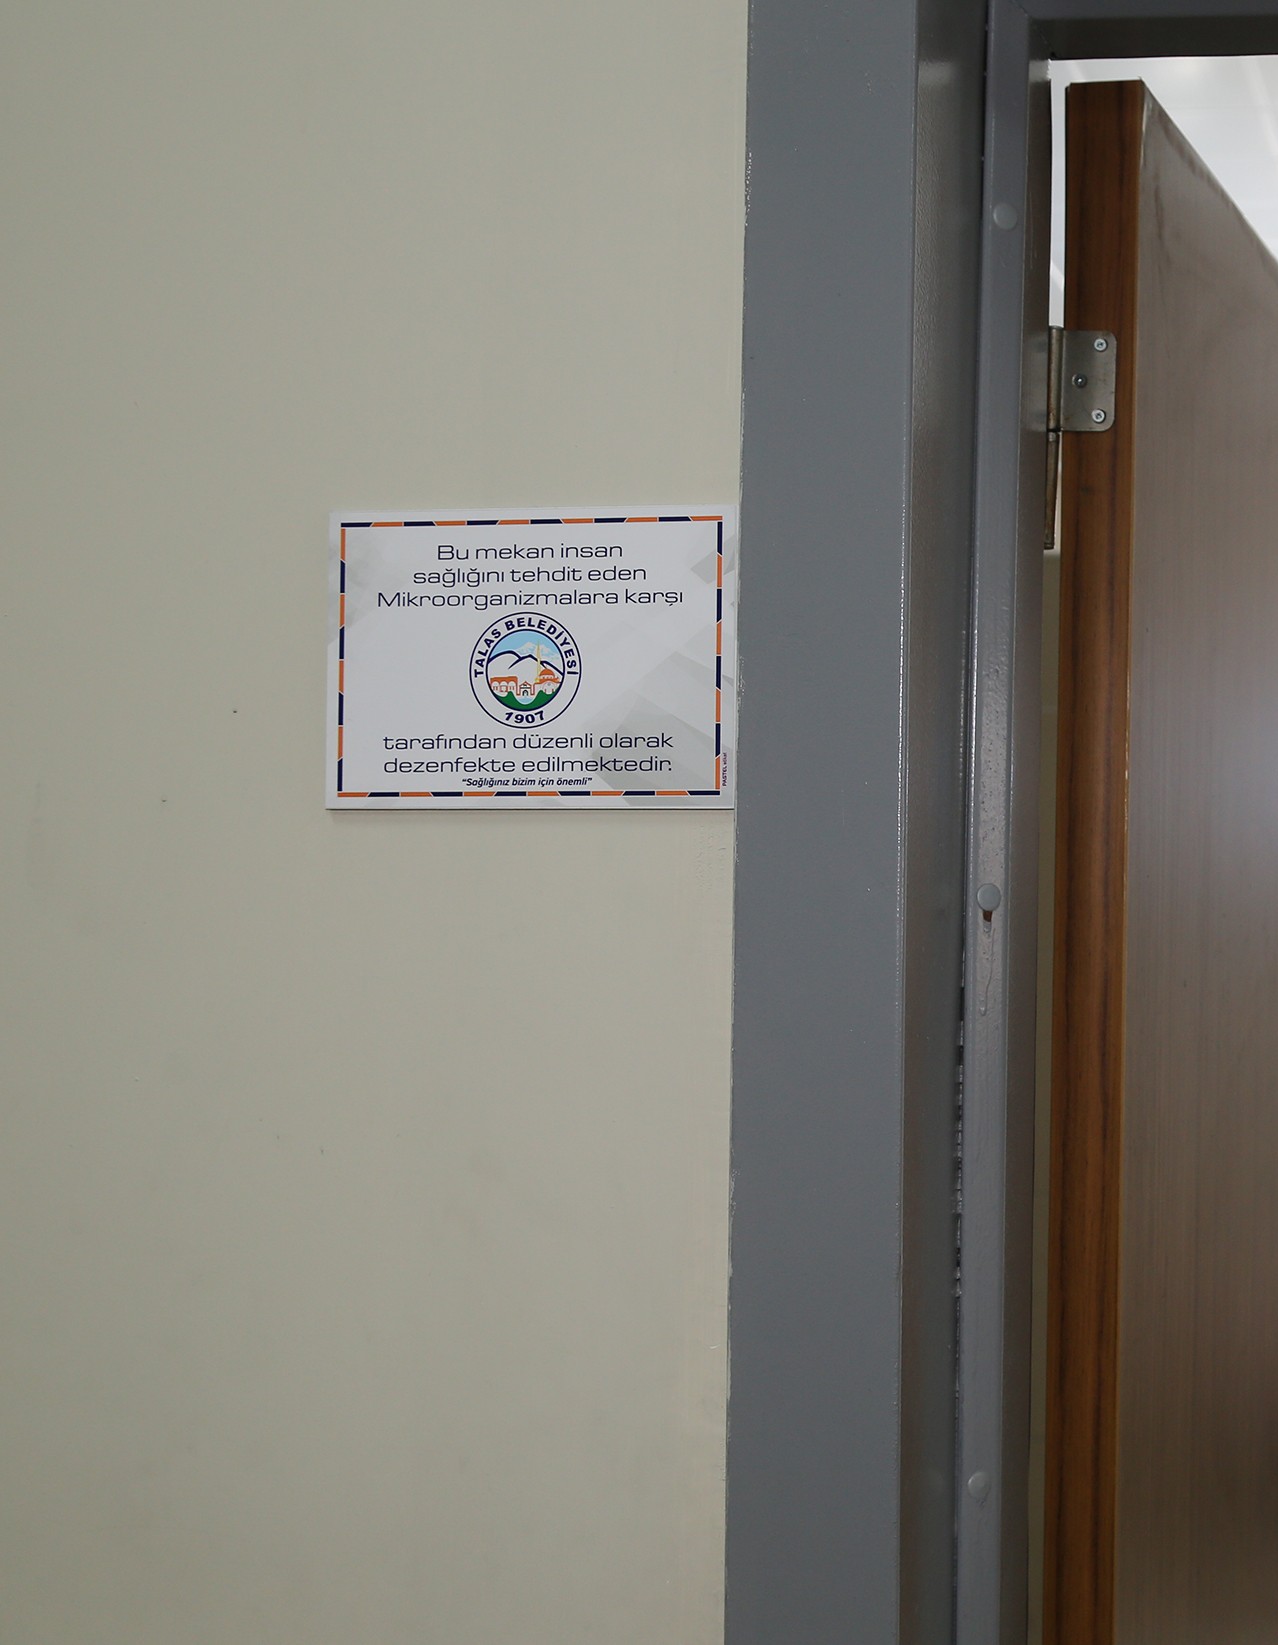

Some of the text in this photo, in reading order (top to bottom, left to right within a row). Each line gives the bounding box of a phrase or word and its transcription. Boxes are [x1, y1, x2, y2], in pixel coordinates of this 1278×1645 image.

[437, 542, 623, 561] Bu mekan insan
[413, 565, 647, 588] sağlığını tehdit eden
[377, 588, 683, 611] Mikroorganizmalara karşı
[474, 617, 579, 678] TALAS BELEDİYESİ
[505, 710, 545, 724] 1907
[382, 732, 674, 750] tarafından düzenli olarak
[383, 755, 672, 774] dezenfekte edilmektedir.
[511, 777, 536, 786] bizim
[537, 777, 555, 788] için
